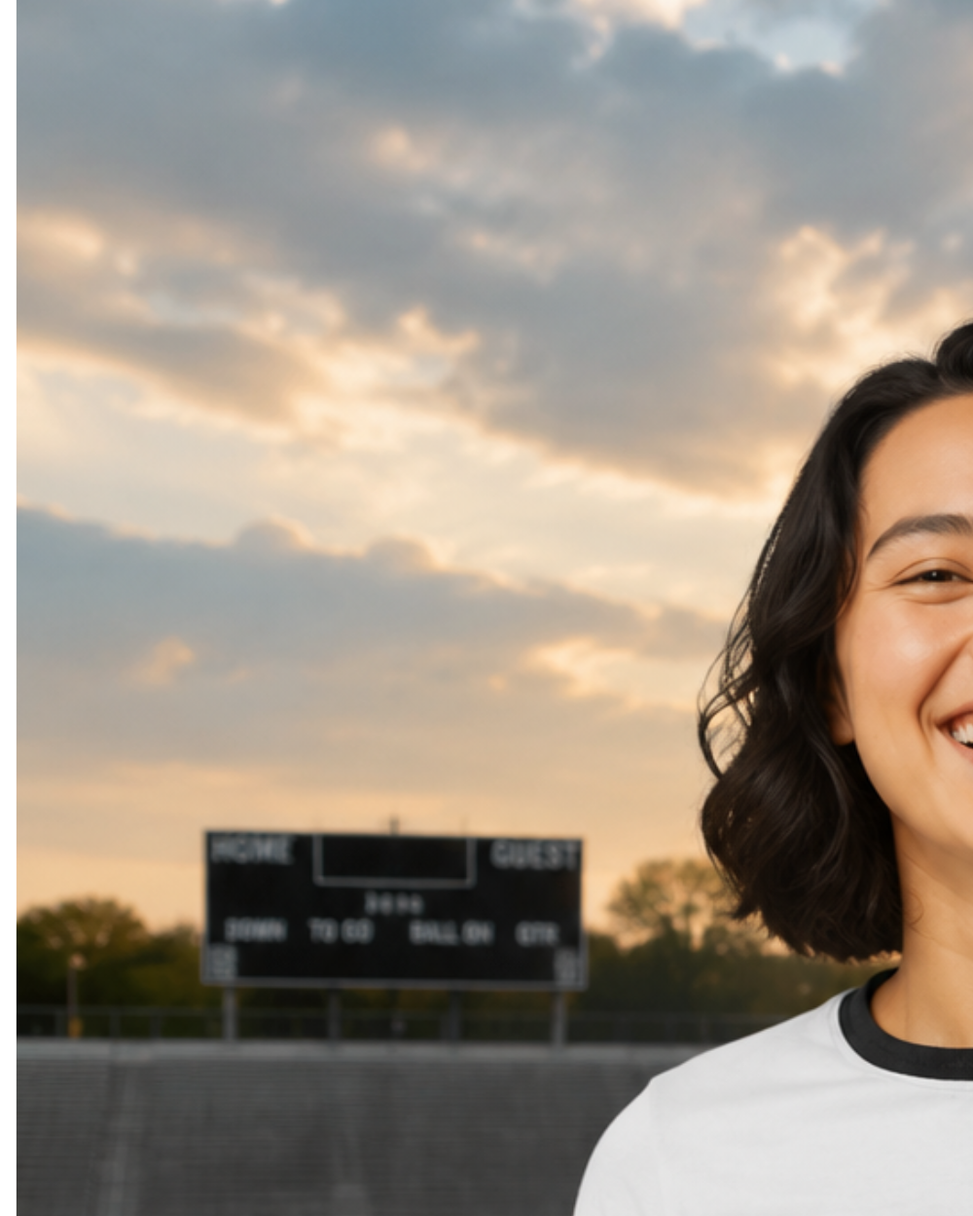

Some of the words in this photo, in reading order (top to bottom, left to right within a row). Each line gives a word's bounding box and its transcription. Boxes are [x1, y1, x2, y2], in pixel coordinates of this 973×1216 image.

[211, 835, 294, 865] HOME
[490, 838, 580, 870] GUEST
[225, 917, 287, 942] DOWN
[409, 920, 460, 945] BALL
